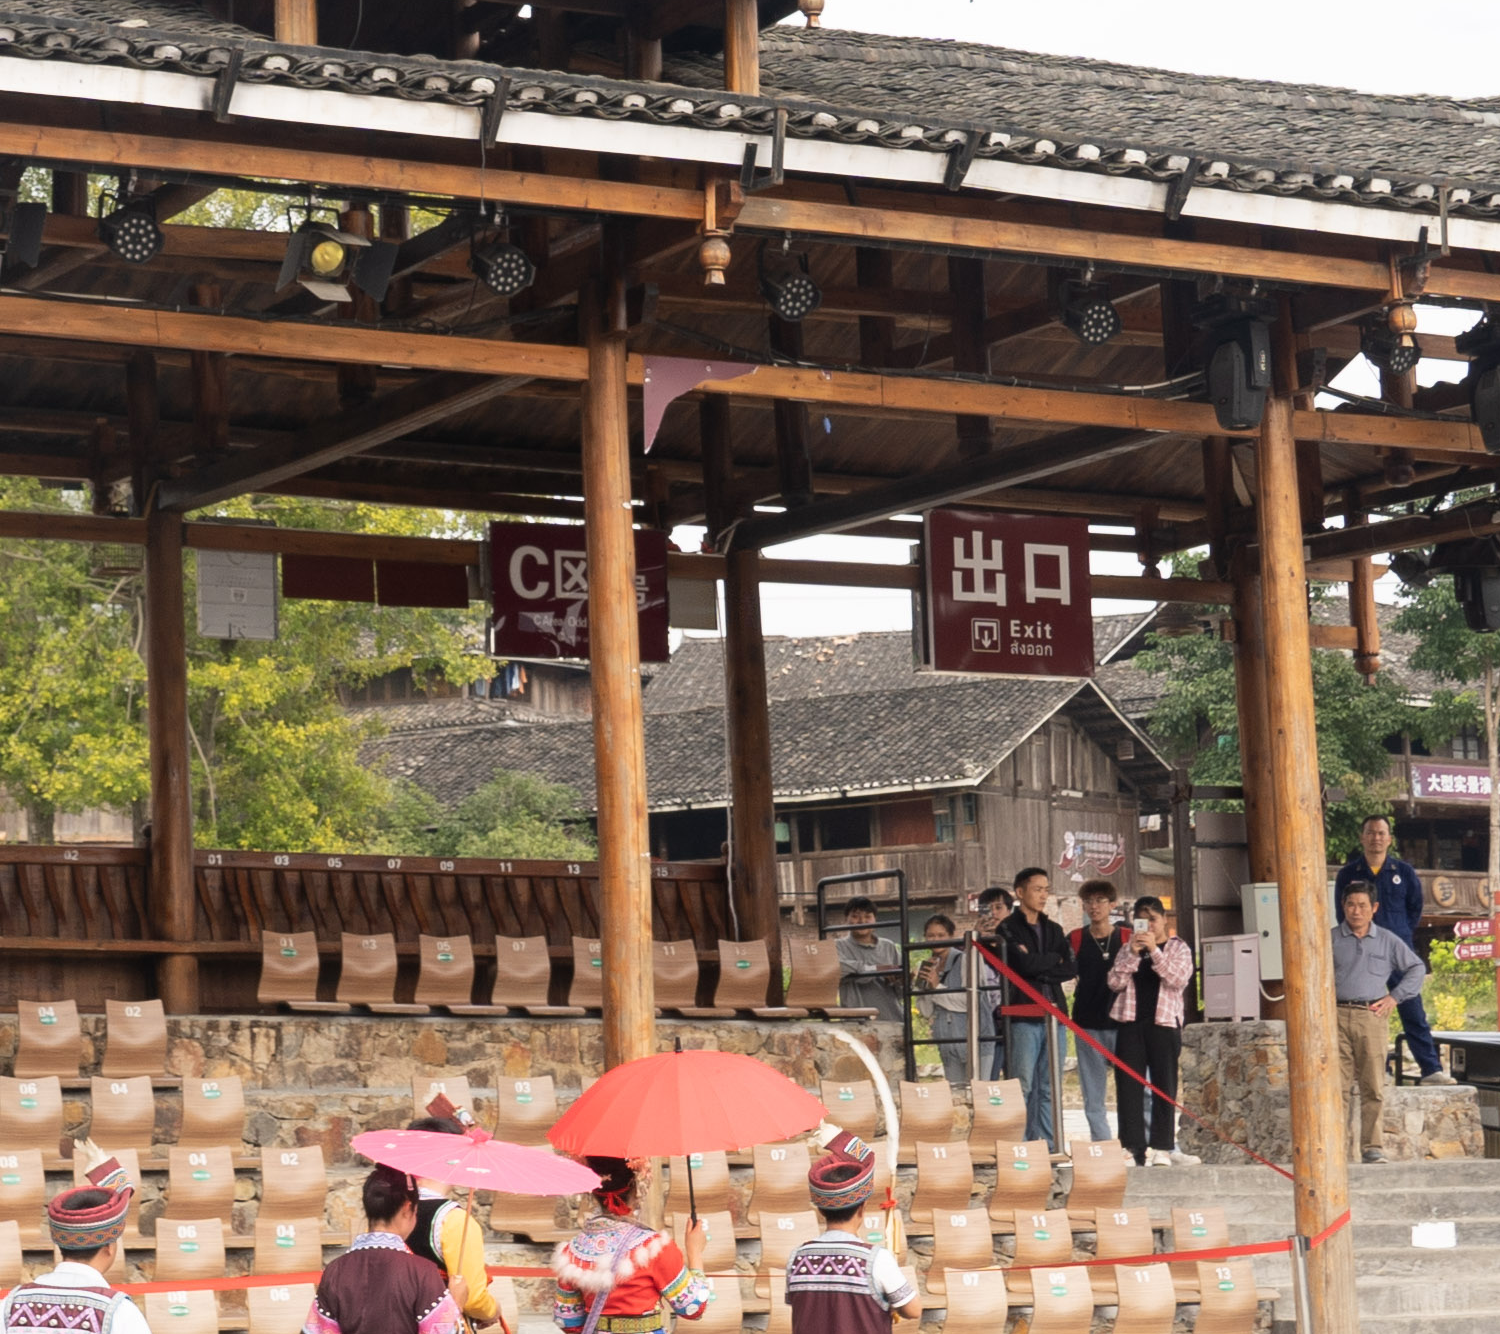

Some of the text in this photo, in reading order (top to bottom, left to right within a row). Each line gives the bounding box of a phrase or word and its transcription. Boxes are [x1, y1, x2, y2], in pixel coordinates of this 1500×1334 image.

[952, 530, 1071, 607] 出口
[1010, 619, 1053, 640] Exit
[64, 850, 79, 861] 02
[208, 854, 222, 865] 01
[274, 855, 289, 866] 03
[327, 858, 342, 868] 05
[387, 859, 401, 869] 07
[440, 861, 454, 871] 09
[499, 862, 513, 873] 11
[568, 864, 581, 875] 13
[804, 944, 818, 955] 15
[125, 1006, 141, 1017] 02
[111, 1083, 128, 1094] 04
[515, 1082, 531, 1093] 03
[988, 1086, 1001, 1097] 15
[771, 1149, 786, 1160] 07
[932, 1147, 947, 1158] 11
[1013, 1146, 1028, 1157] 13
[1088, 1145, 1103, 1157] 15
[0, 1156, 18, 1168] 08
[189, 1153, 207, 1165] 04
[281, 1153, 298, 1165] 02
[866, 1216, 879, 1228] 07
[1032, 1215, 1046, 1227] 11
[1113, 1213, 1128, 1225] 13
[1189, 1213, 1204, 1225] 15
[275, 1225, 294, 1237] 04
[1216, 1267, 1229, 1279] 13
